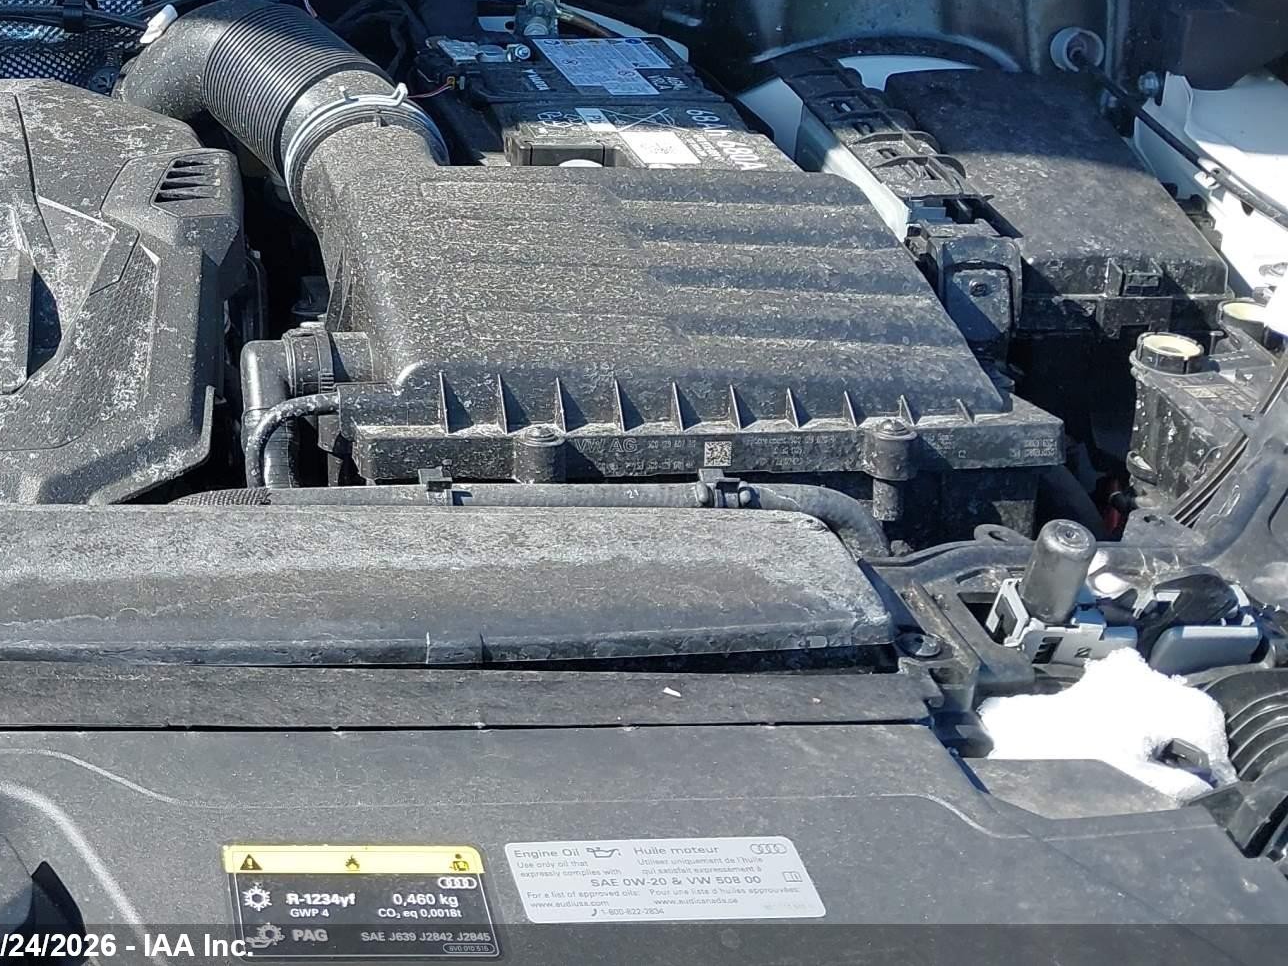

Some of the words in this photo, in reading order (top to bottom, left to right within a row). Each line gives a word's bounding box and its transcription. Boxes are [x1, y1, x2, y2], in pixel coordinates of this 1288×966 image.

[574, 438, 606, 453] VW
[608, 438, 638, 453] AG
[513, 848, 559, 859] Engine
[561, 848, 581, 857] Oil
[633, 846, 667, 855] Huile
[670, 846, 720, 855] moteur
[516, 861, 534, 869] Use
[536, 860, 555, 870] only
[557, 860, 569, 868] oil
[637, 858, 671, 866] Utiliser
[673, 857, 723, 866] uniquement
[519, 870, 561, 879] expressly
[562, 869, 601, 878] complies
[602, 868, 622, 876] with
[641, 867, 657, 876] qui
[658, 866, 692, 874] satisfait
[590, 879, 620, 887] SAE
[623, 877, 668, 887] 0W-20
[671, 876, 682, 885] &
[685, 876, 711, 885] VW
[715, 876, 741, 885] 508
[745, 875, 762, 884] 00
[526, 891, 542, 899] For
[567, 890, 576, 898] of
[578, 890, 620, 899] approved
[649, 888, 670, 896] Pour
[285, 892, 357, 907] R-1234yf
[392, 893, 436, 907] 0,460
[439, 893, 459, 908] kg
[530, 900, 610, 909] www.audiusa.com
[654, 897, 739, 905] www.audicanada.ca
[290, 908, 319, 918] GWP
[322, 908, 330, 918] 4
[403, 909, 418, 919] eq
[600, 908, 665, 916] 1-800-822-2834
[292, 928, 329, 942] PAG
[360, 931, 386, 942] SAE
[389, 931, 417, 942] J639
[419, 931, 454, 942] J2842
[456, 931, 492, 942] J2845
